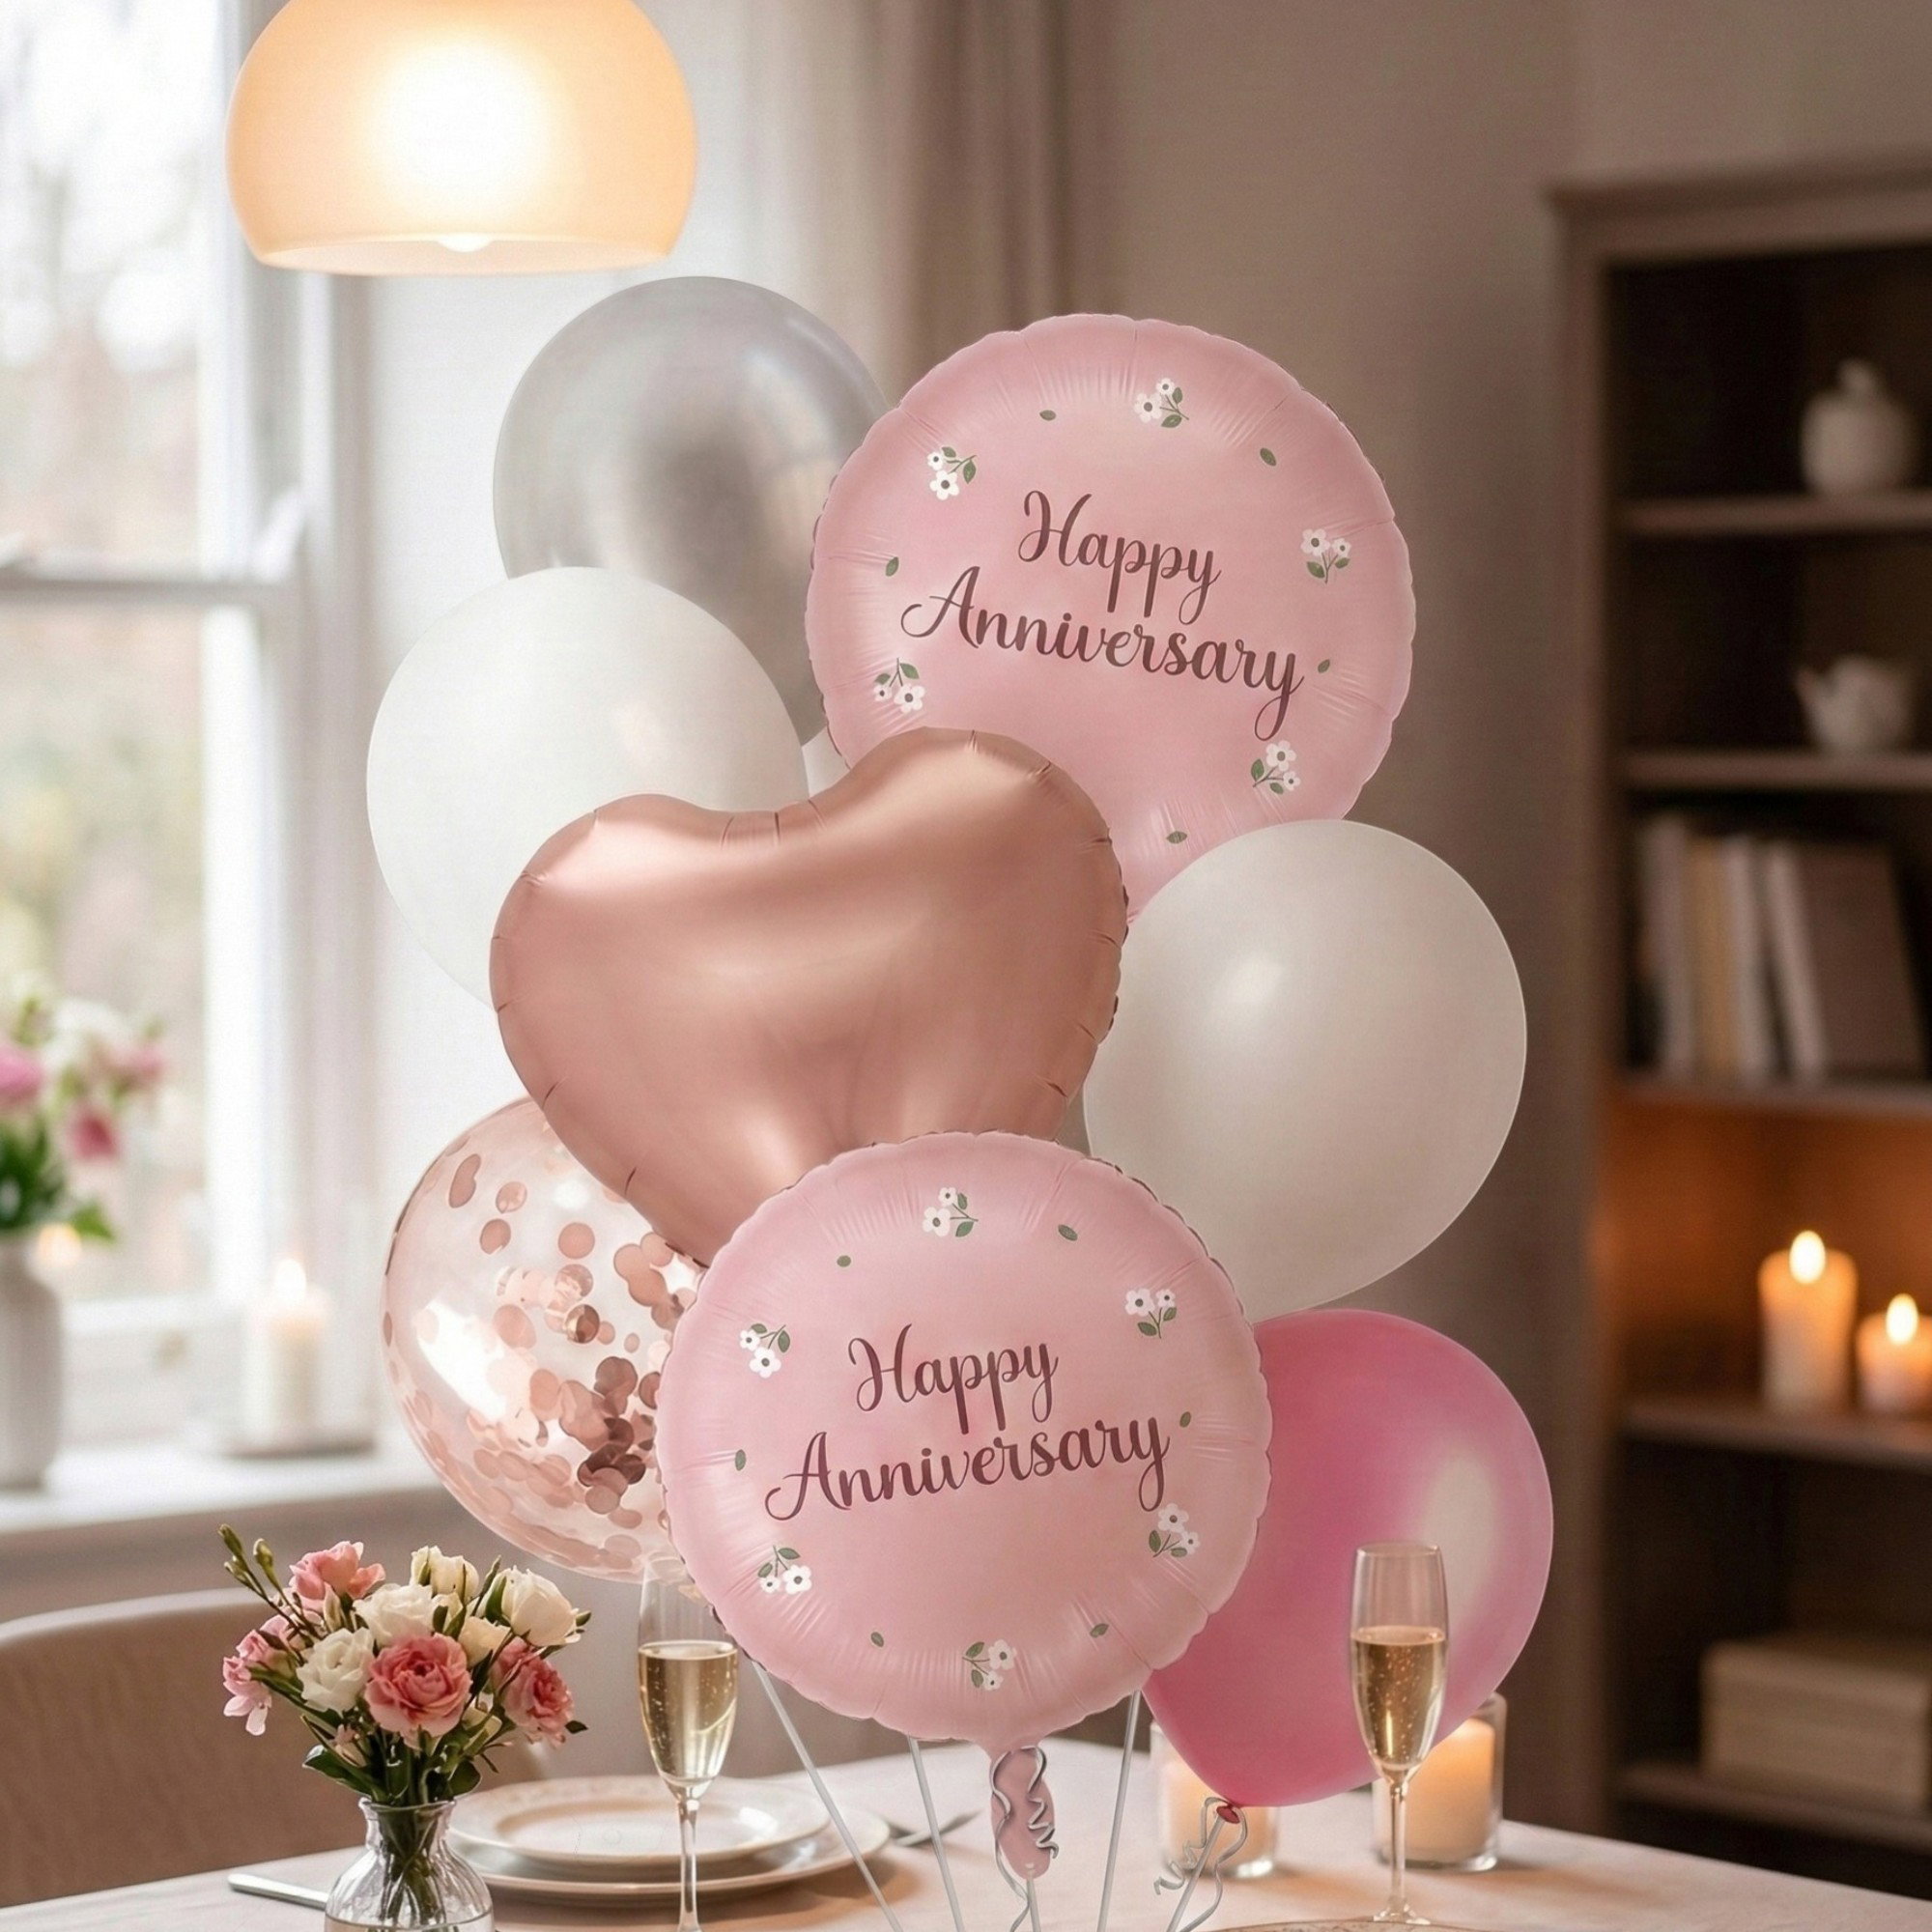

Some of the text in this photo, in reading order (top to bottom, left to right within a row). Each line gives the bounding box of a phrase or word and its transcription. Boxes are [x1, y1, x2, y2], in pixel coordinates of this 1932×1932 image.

[1018, 491, 1222, 625] Happy
[900, 566, 1305, 742] Anniversary
[848, 1323, 1059, 1435] Happy
[764, 1417, 1171, 1521] Anniversary
